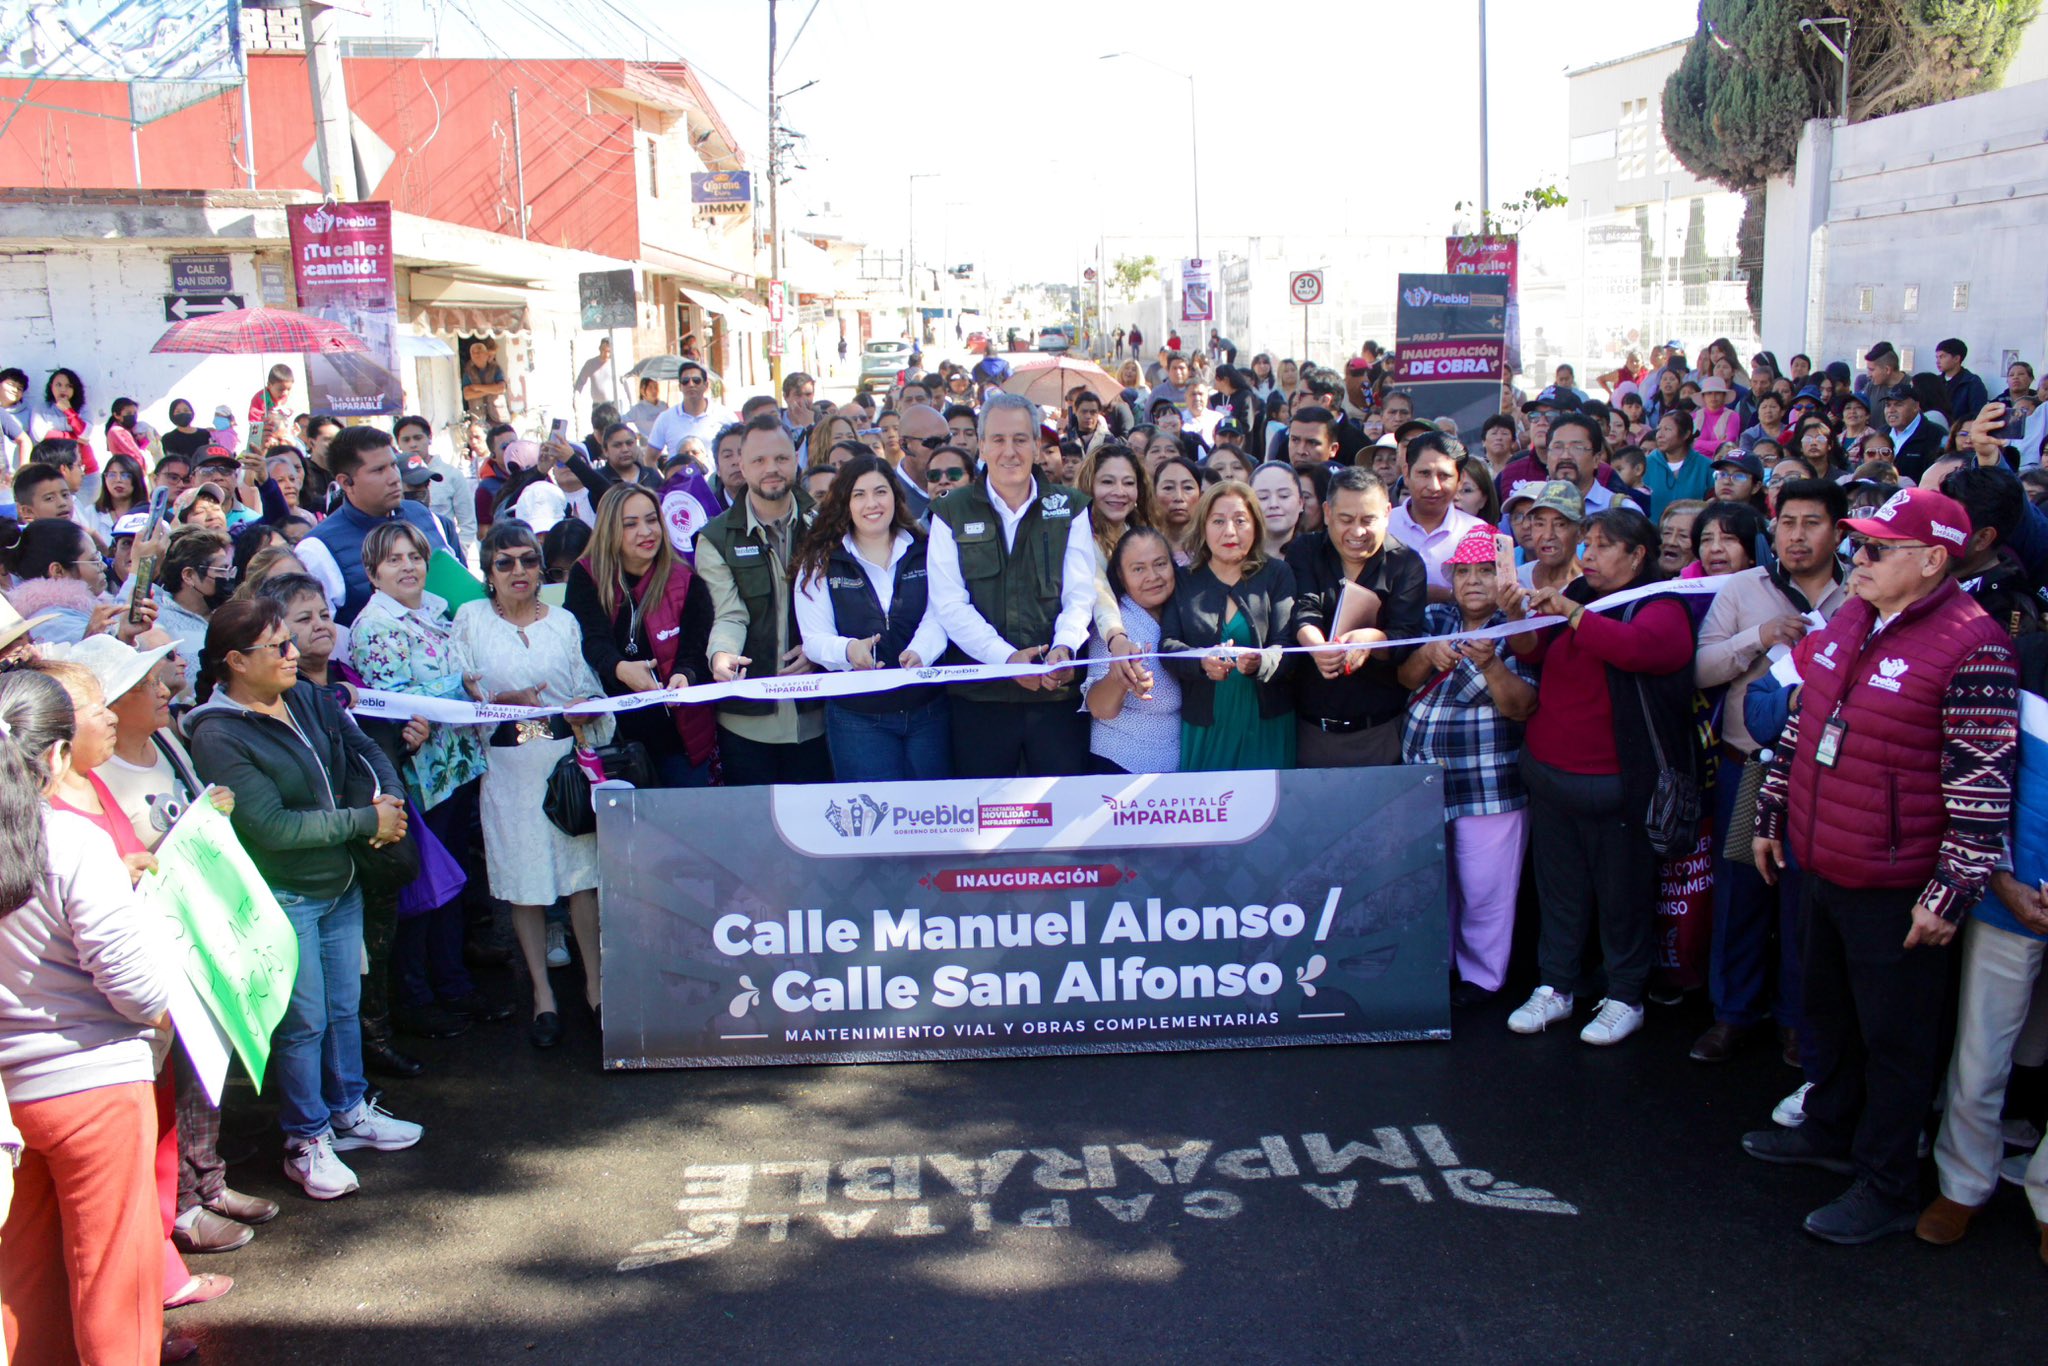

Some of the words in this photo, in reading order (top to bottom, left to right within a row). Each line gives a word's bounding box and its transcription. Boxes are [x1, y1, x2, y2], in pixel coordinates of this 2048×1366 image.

[699, 204, 746, 214] JIMMY
[336, 216, 376, 228] Puebla
[304, 243, 331, 261] ¡Tu
[334, 241, 376, 256] calle
[186, 265, 215, 274] CALLE
[306, 258, 376, 276] cambió!
[177, 276, 196, 286] SAN
[198, 276, 227, 286] ISIDRO
[1300, 278, 1314, 288] 30
[1432, 294, 1469, 304] Puebla
[1412, 333, 1438, 342] PASO
[1402, 344, 1498, 360] INAUGURACIÓN
[1410, 360, 1434, 375] DE
[1437, 358, 1489, 374] OBRA
[332, 400, 383, 410] IMPARABLE
[765, 685, 820, 694] IMPARABLE
[358, 698, 386, 708] uebla
[1120, 800, 1138, 808] LA
[1147, 797, 1216, 808] CAPITAL
[893, 804, 974, 826] Puebla
[982, 810, 1031, 818] MOVILIDAD
[1032, 810, 1038, 818] E
[982, 818, 1050, 826] INFRAESTRUCTURA
[1114, 808, 1228, 826] IMPARABLE
[1674, 857, 1712, 877] COMO
[956, 868, 1099, 888] INAUGURACIÓN
[1660, 872, 1714, 897] PAVIMEN
[1656, 900, 1688, 916] ONSO
[712, 908, 860, 956] Calle
[873, 900, 1086, 952] Manuel
[1100, 898, 1306, 944] Alonso
[772, 966, 920, 1012] Calle
[931, 965, 1041, 1008] San
[1054, 956, 1283, 1004] Alfonso
[785, 1024, 946, 1042] MANTENIMIENTO
[953, 1023, 996, 1036] VIAL
[1003, 1022, 1014, 1034] Y
[1022, 1020, 1086, 1035] OBRAS
[1094, 1012, 1280, 1032] COMPLEMENTARIAS
[676, 1124, 1460, 1211] IMPARABLE
[1302, 1175, 1434, 1209] LA
[744, 1190, 1243, 1243] CAPITAL
